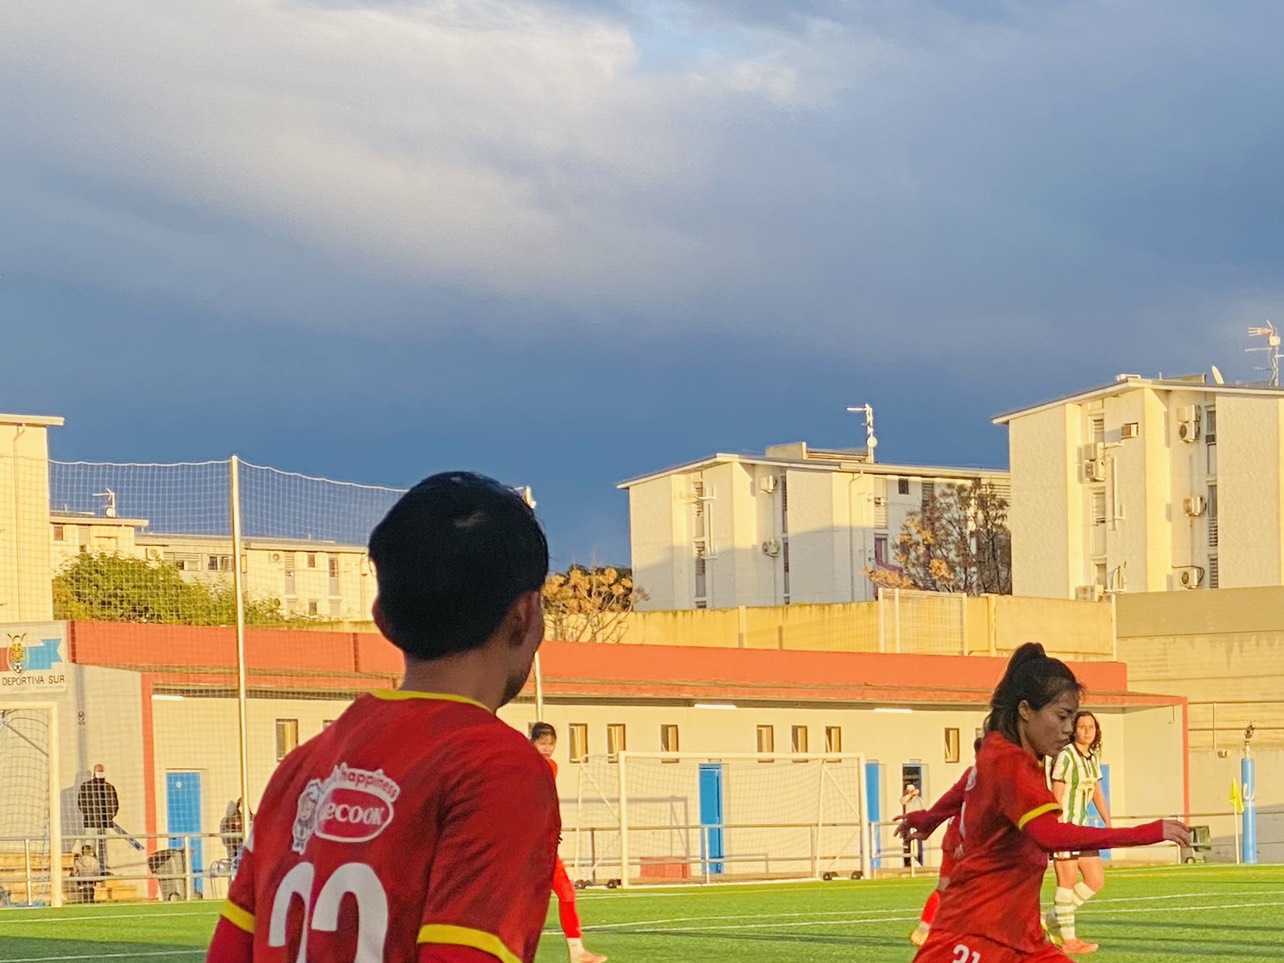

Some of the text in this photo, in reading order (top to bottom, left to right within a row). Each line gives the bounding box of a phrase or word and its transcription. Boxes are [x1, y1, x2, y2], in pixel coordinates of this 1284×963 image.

[2, 674, 65, 686] DEPORTIVA SUR
[341, 769, 399, 799] happiness
